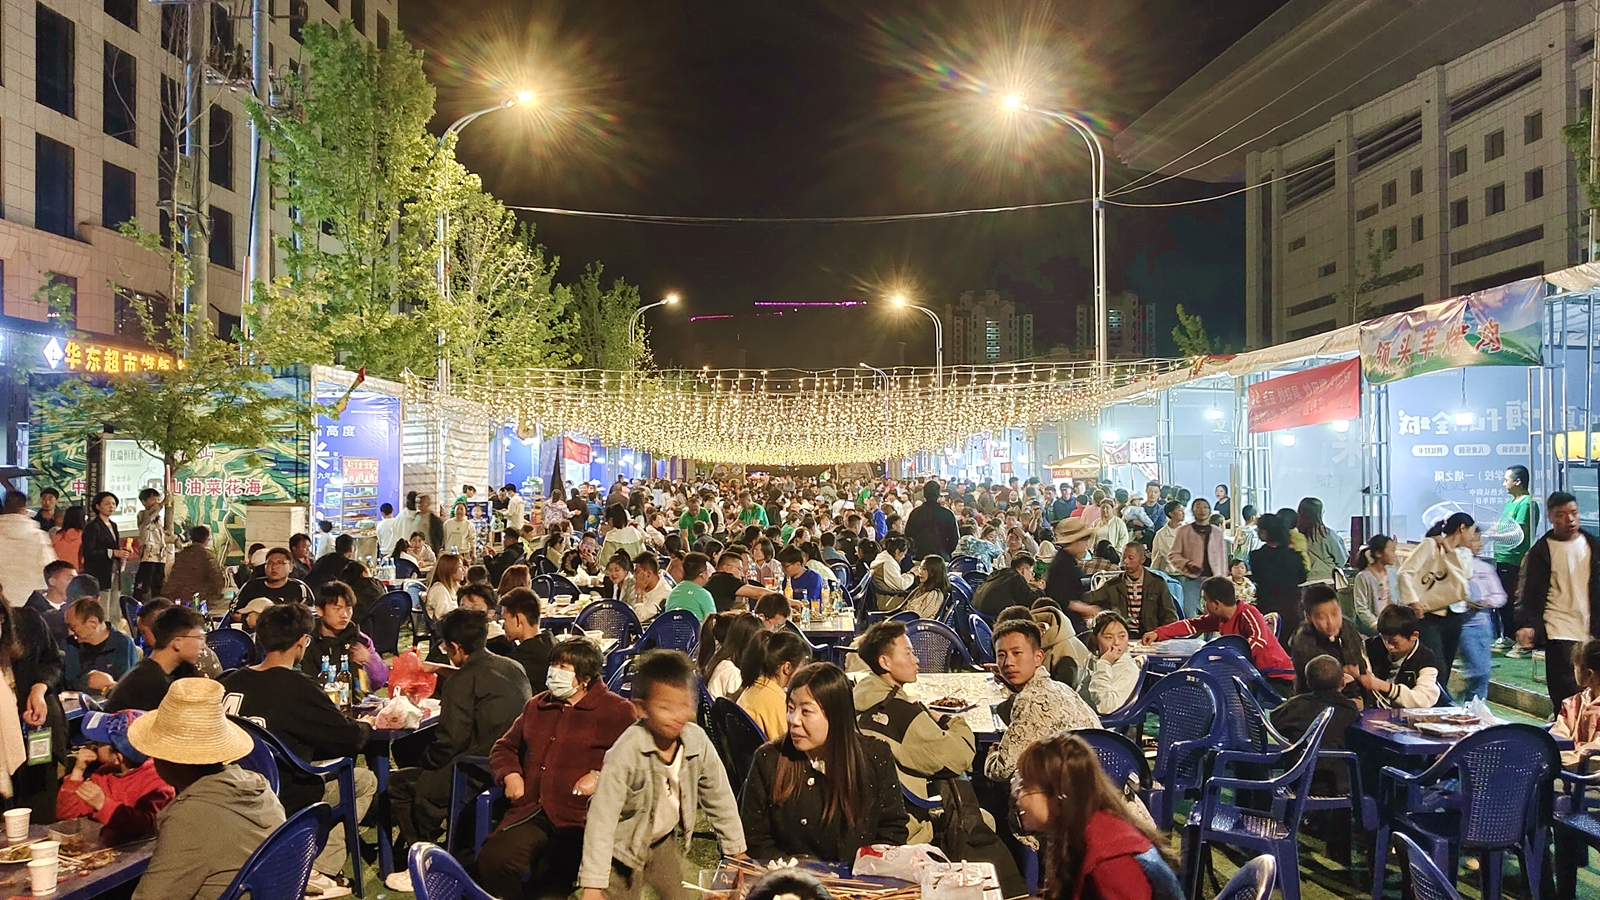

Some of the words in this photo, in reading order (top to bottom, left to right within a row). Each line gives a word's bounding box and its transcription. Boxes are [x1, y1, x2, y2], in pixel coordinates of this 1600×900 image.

[1376, 318, 1502, 372] 领头羊烤肉
